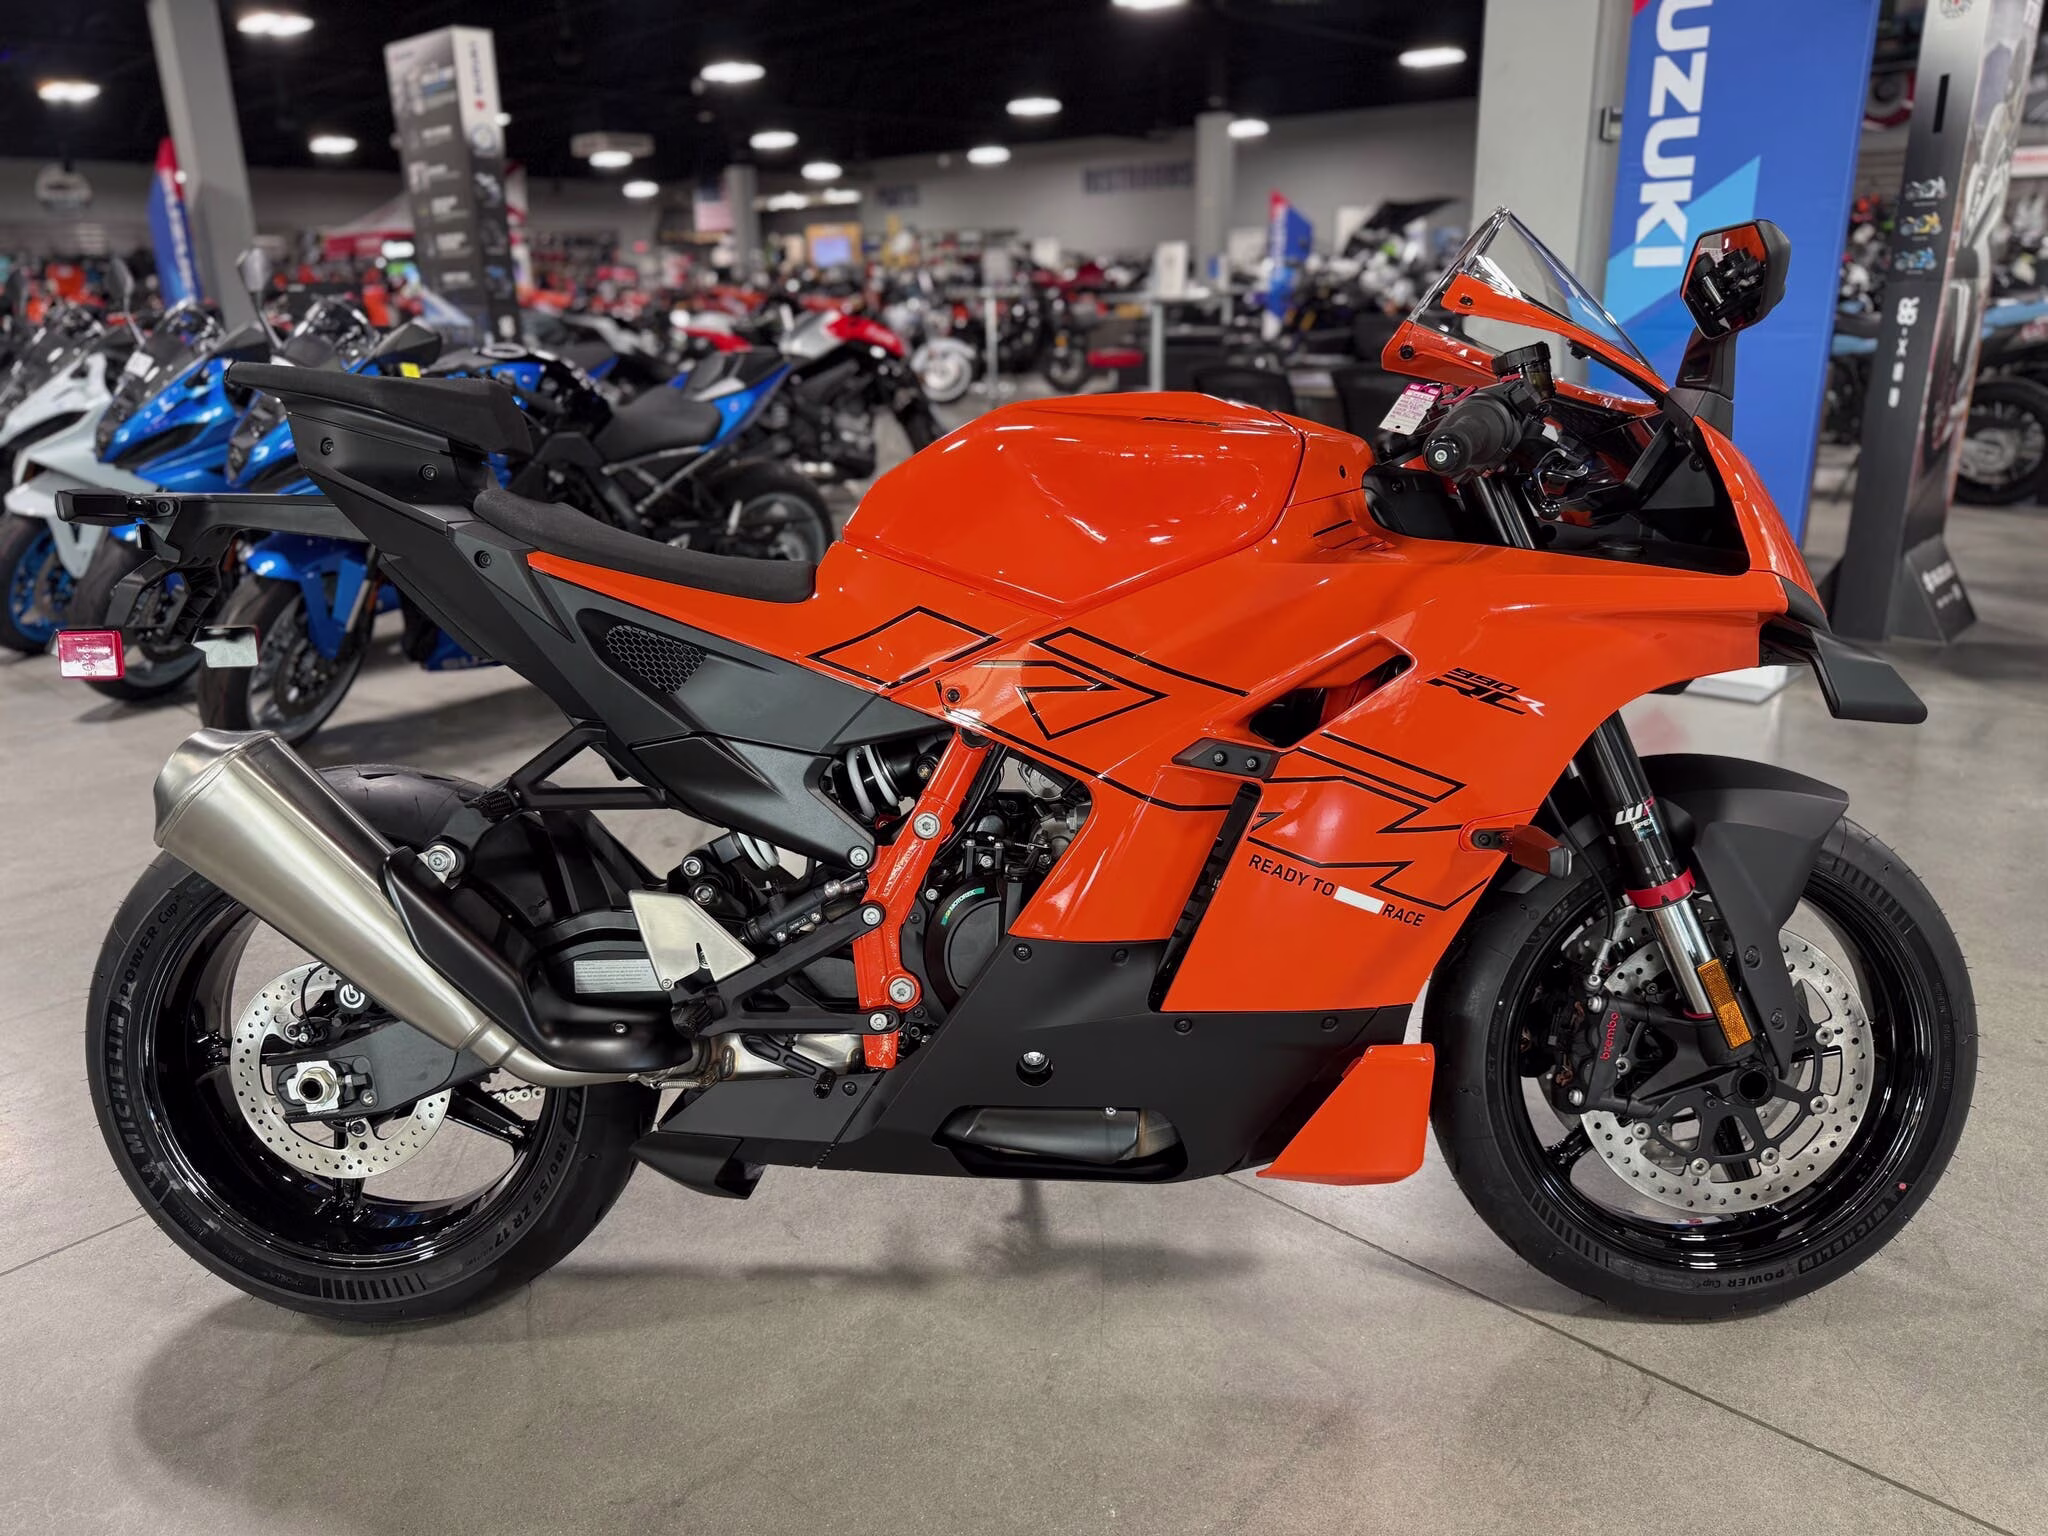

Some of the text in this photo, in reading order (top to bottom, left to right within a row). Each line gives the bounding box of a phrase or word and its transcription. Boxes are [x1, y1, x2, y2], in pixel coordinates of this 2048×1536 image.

[1249, 854, 1425, 927] READY TO RACE
[119, 924, 158, 998] POWER
[1600, 1012, 1619, 1060] brembo
[108, 1012, 146, 1155] MICHELIN
[494, 1226, 511, 1247] 17
[513, 1203, 532, 1229] ZR
[1800, 1202, 1889, 1273] MICHELIN
[1727, 1268, 1785, 1289] POWER
